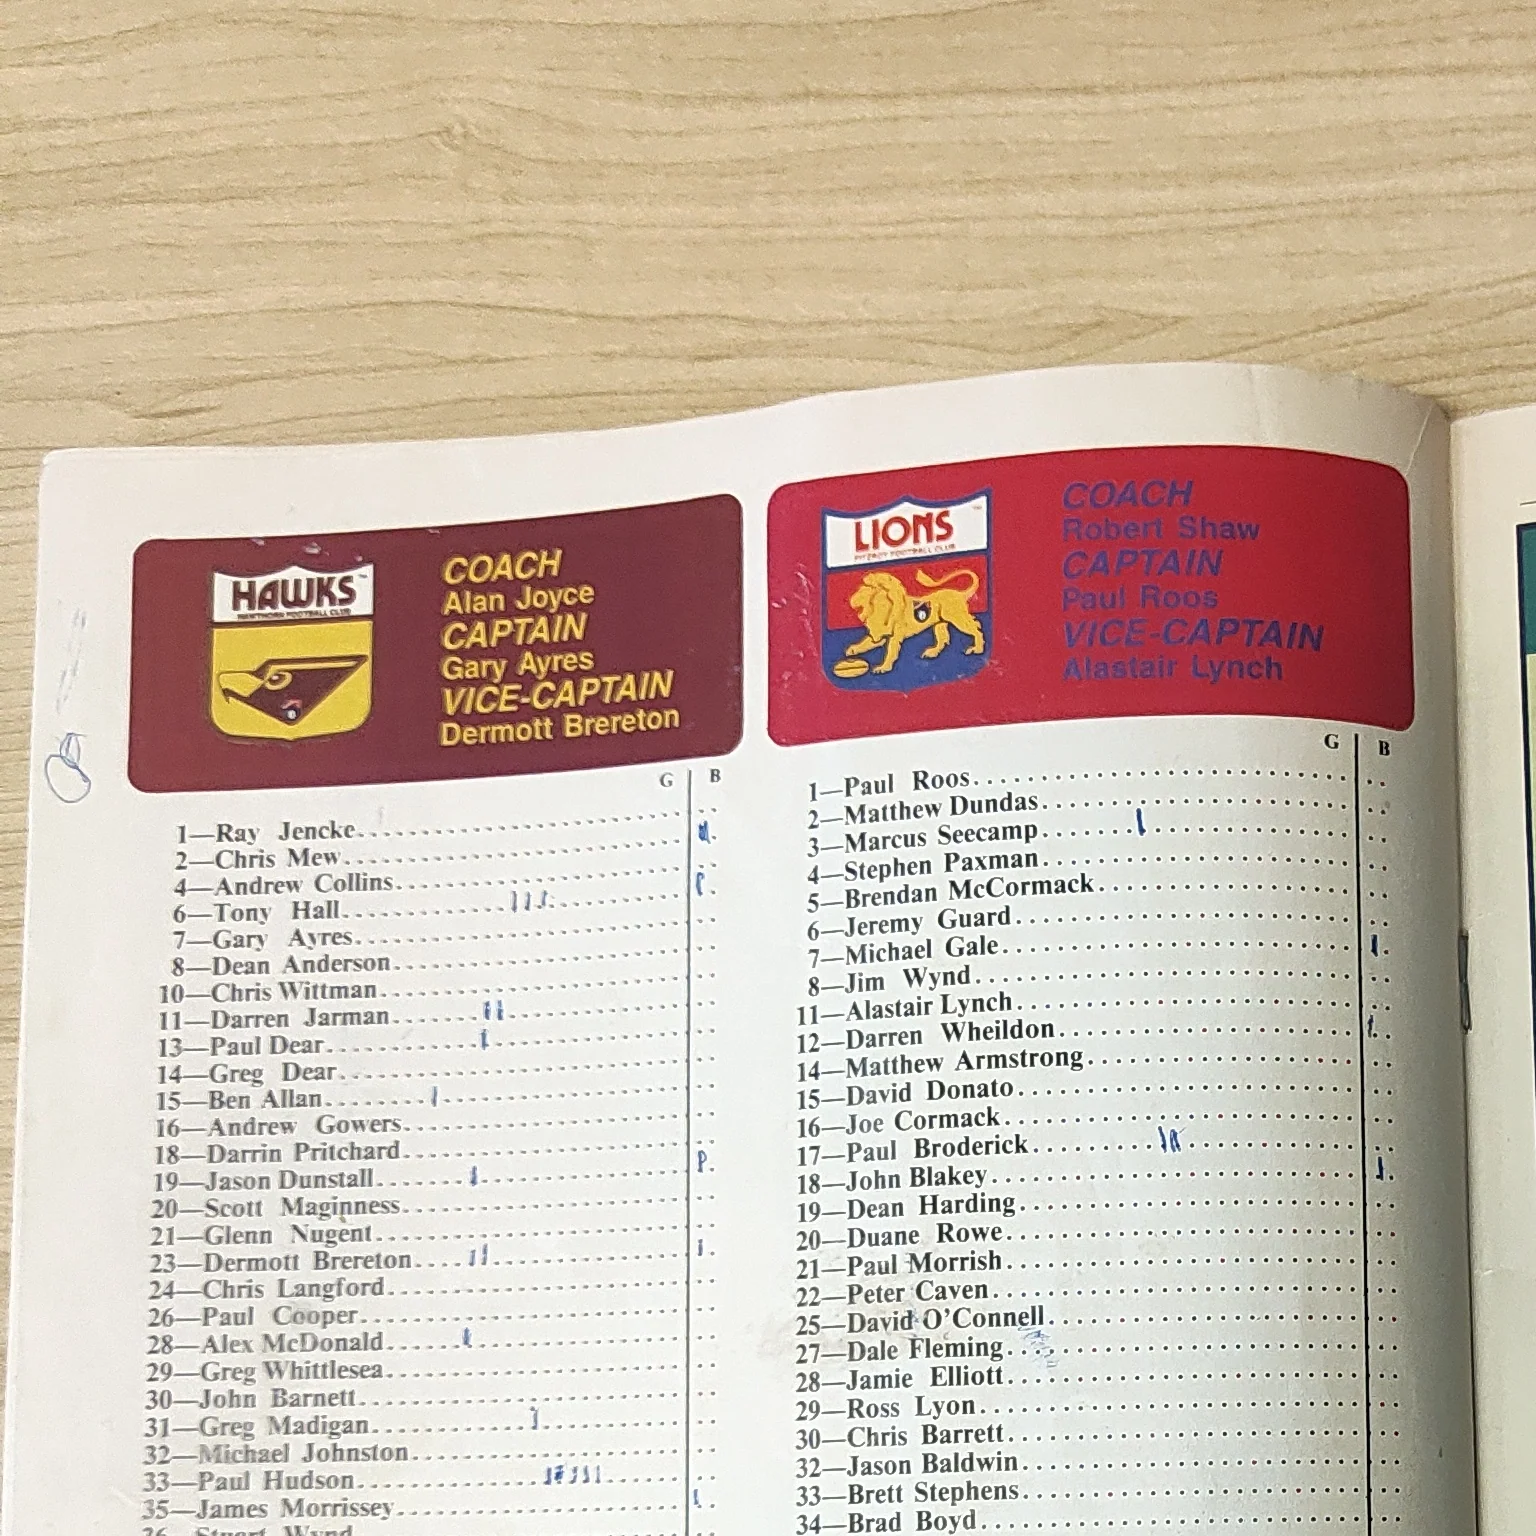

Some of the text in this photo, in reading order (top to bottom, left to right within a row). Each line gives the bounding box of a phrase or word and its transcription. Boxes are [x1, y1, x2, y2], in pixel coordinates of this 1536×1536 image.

[1063, 480, 1193, 509] COACH
[855, 510, 953, 552] LIONS
[1062, 516, 1259, 541] Robert Shaw
[443, 548, 563, 585] COACH
[1063, 549, 1224, 579] CAPTAIN
[232, 575, 356, 611] HAWKS
[443, 585, 595, 615] Alan Joyce
[1062, 584, 1218, 611] Paul Roos
[442, 612, 588, 650] CAPTAIN
[1064, 618, 1324, 651] VICE-CAPTAIN
[442, 651, 595, 683] Gary Ayres
[1063, 654, 1283, 684] Alastair Lynch
[442, 669, 674, 716] VICE-CAPTAIN
[440, 708, 680, 747] Dermott Brereton
